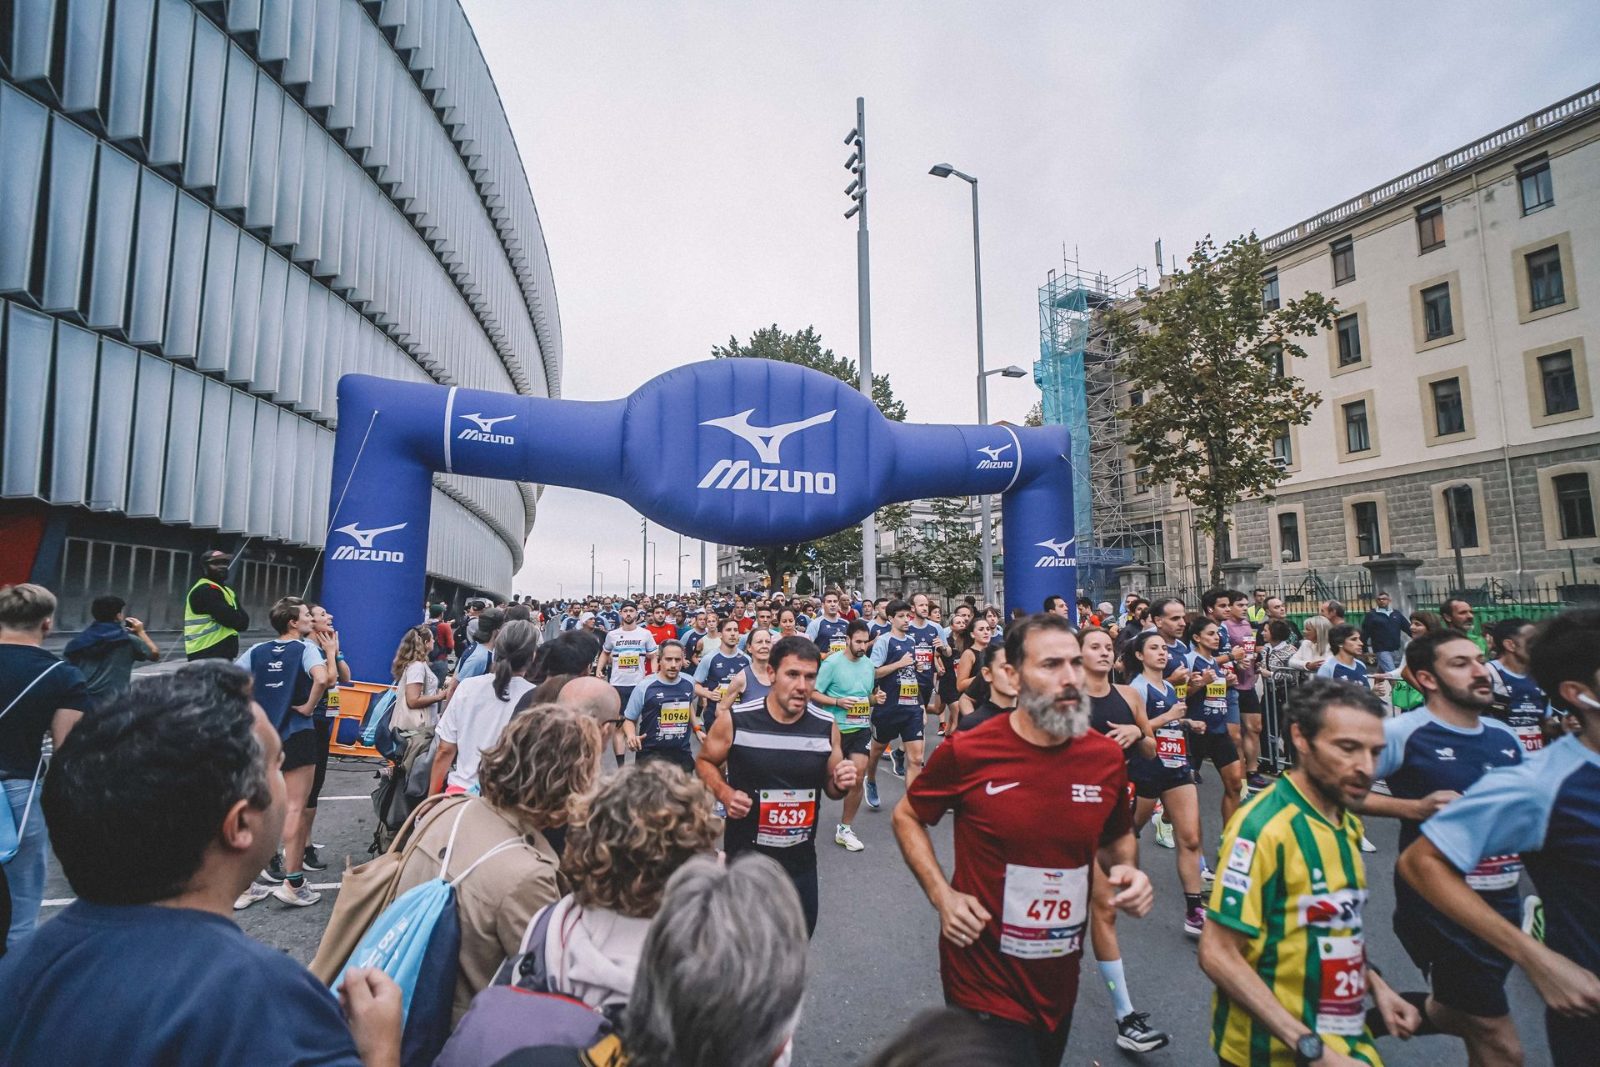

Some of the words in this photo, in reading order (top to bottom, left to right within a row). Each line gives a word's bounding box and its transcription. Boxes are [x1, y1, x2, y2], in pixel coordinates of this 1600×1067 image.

[457, 428, 515, 445] MIZUNO
[696, 459, 836, 495] MIZUNO
[331, 545, 404, 563] MIZUNO
[1034, 555, 1077, 568] MIZUN
[1160, 741, 1183, 753] 3996
[768, 808, 807, 825] 5639
[1026, 899, 1072, 921] 478
